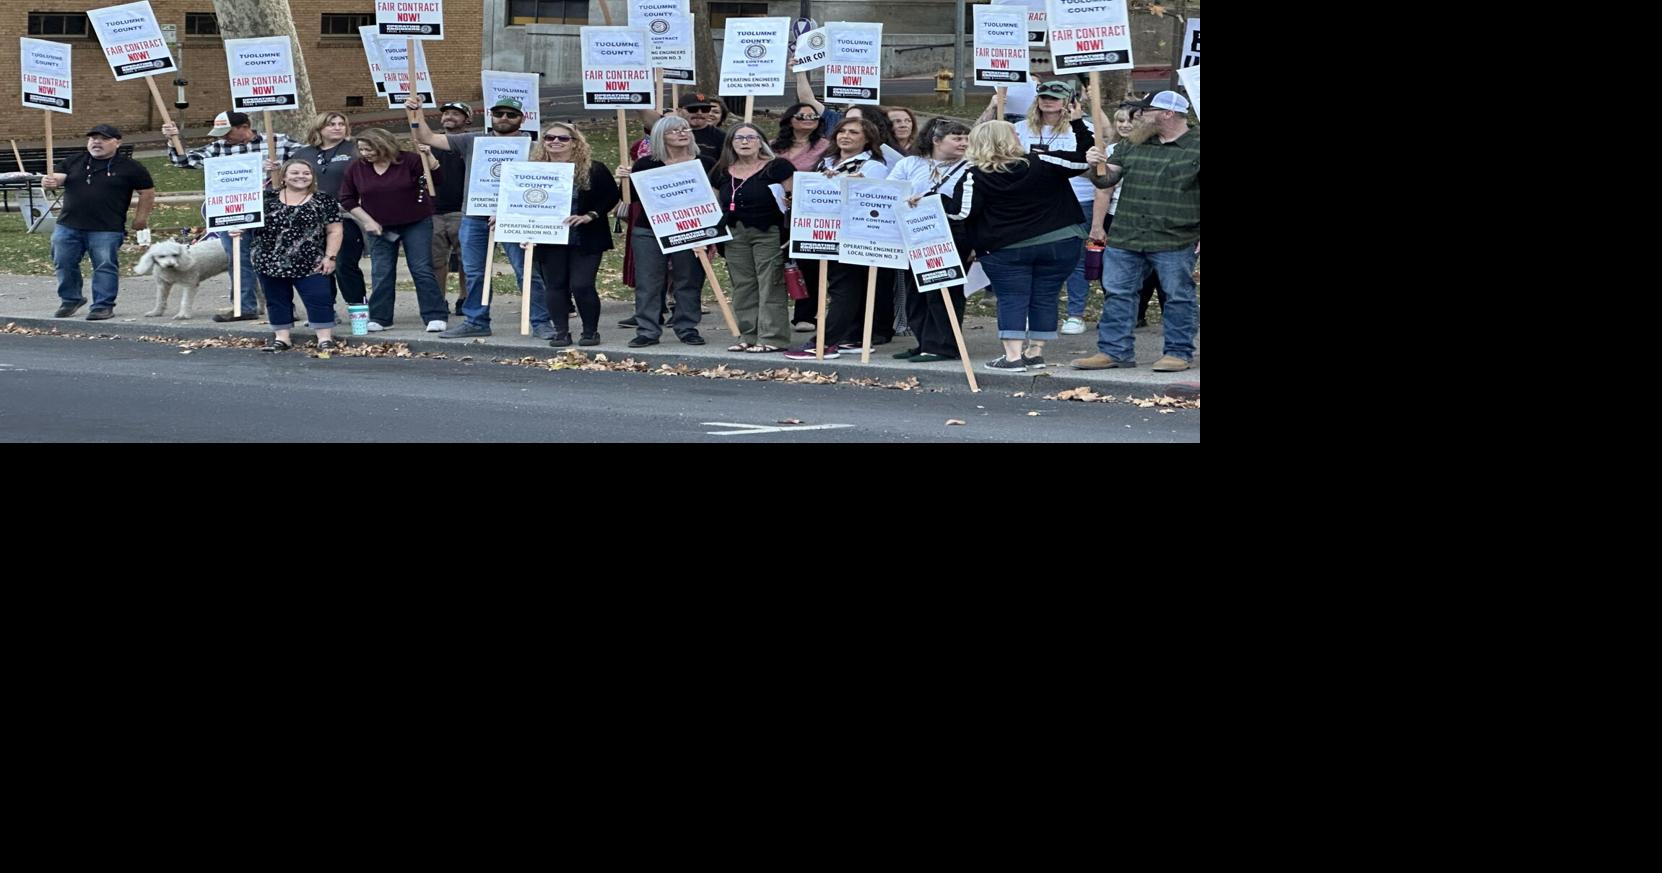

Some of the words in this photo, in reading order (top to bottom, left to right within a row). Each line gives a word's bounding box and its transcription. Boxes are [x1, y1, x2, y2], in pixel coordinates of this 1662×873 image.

[378, 2, 395, 11] FAIR
[397, 3, 439, 12] CONTRACT
[106, 18, 144, 27] TUOLUMNE
[397, 13, 420, 22] NOW!
[1052, 30, 1072, 41] FAIR
[1076, 25, 1125, 39] CONTRACT
[106, 46, 124, 55] FAIR
[124, 38, 163, 52] CONTRACT
[1076, 40, 1104, 52] NOW!
[128, 51, 150, 62] NOW!
[976, 48, 989, 56] FAIR
[991, 48, 1026, 58] CONTRACT
[991, 59, 1009, 68] NOW!
[585, 70, 603, 80] FAIR
[606, 70, 649, 80] CONTRACT
[827, 65, 841, 74] FAIR
[844, 65, 878, 75] CONTRACT
[24, 74, 37, 83] FAIR
[39, 76, 69, 88] CONTRACT
[232, 78, 249, 86] FAIR
[252, 75, 292, 85] CONTRACT
[384, 73, 397, 81] FAIR
[398, 72, 427, 81] CONACT
[843, 76, 862, 85] NOW!
[39, 86, 56, 95] NOW!
[253, 86, 275, 95] NOW!
[606, 81, 630, 91] NOW!
[651, 179, 697, 191] TUOLUMNE
[660, 188, 694, 198] COUNTY
[855, 192, 897, 200] TUOLUMNE
[208, 196, 223, 205] FAIR
[225, 192, 260, 203] CONTRACT
[225, 204, 244, 213] NOW!
[651, 213, 671, 224] FAIR
[672, 202, 717, 220] CONTRACT
[793, 218, 811, 227] FAIR
[814, 219, 840, 229] CONTR
[906, 214, 937, 224] TUOLUMNE
[676, 218, 702, 231] NOW!
[912, 224, 936, 232] COUNTY
[813, 230, 836, 240] NOW!
[909, 249, 923, 260] FAIR
[923, 242, 954, 257] CONTRACT
[926, 256, 944, 269] NOW!
